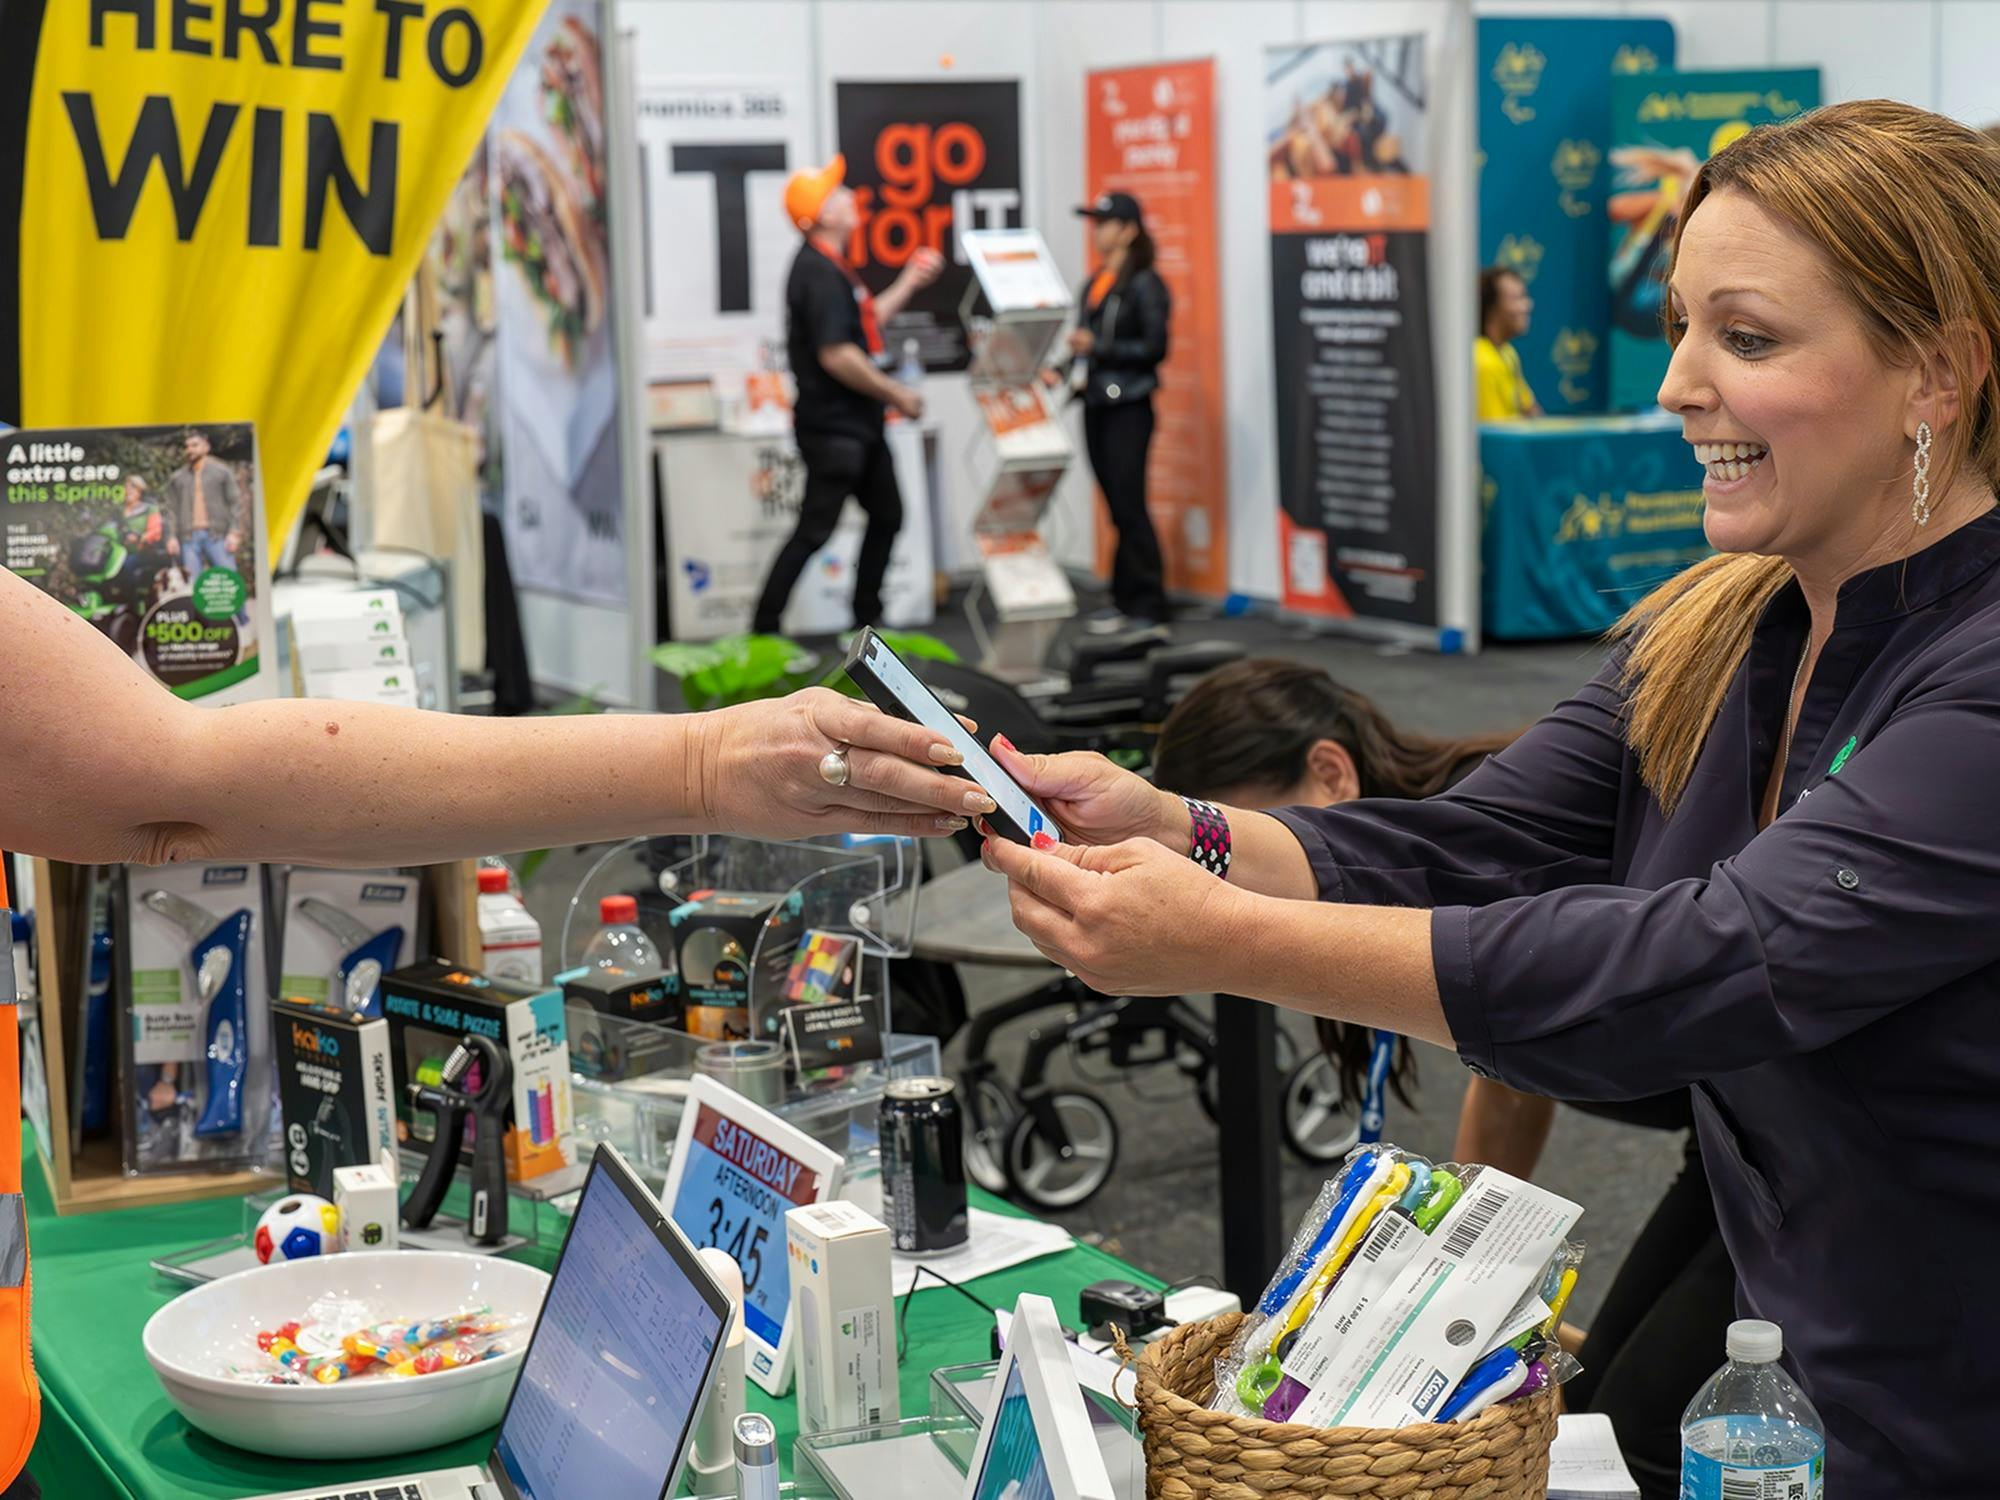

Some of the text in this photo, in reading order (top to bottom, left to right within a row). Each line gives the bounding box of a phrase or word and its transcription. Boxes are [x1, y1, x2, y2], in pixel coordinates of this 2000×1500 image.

[89, 0, 484, 89] HERE TO
[61, 91, 400, 258] WIN
[875, 122, 986, 207] go
[7, 442, 85, 464] A little
[7, 464, 120, 484] extra care
[7, 481, 126, 505] this Spring
[156, 610, 190, 623] PLUS
[147, 621, 204, 643] $500
[713, 1118, 802, 1198] SATURDAY
[714, 1163, 782, 1222] AFTERNOON
[1548, 1213, 1569, 1238] Features
[1339, 1318, 1353, 1334] AUD
